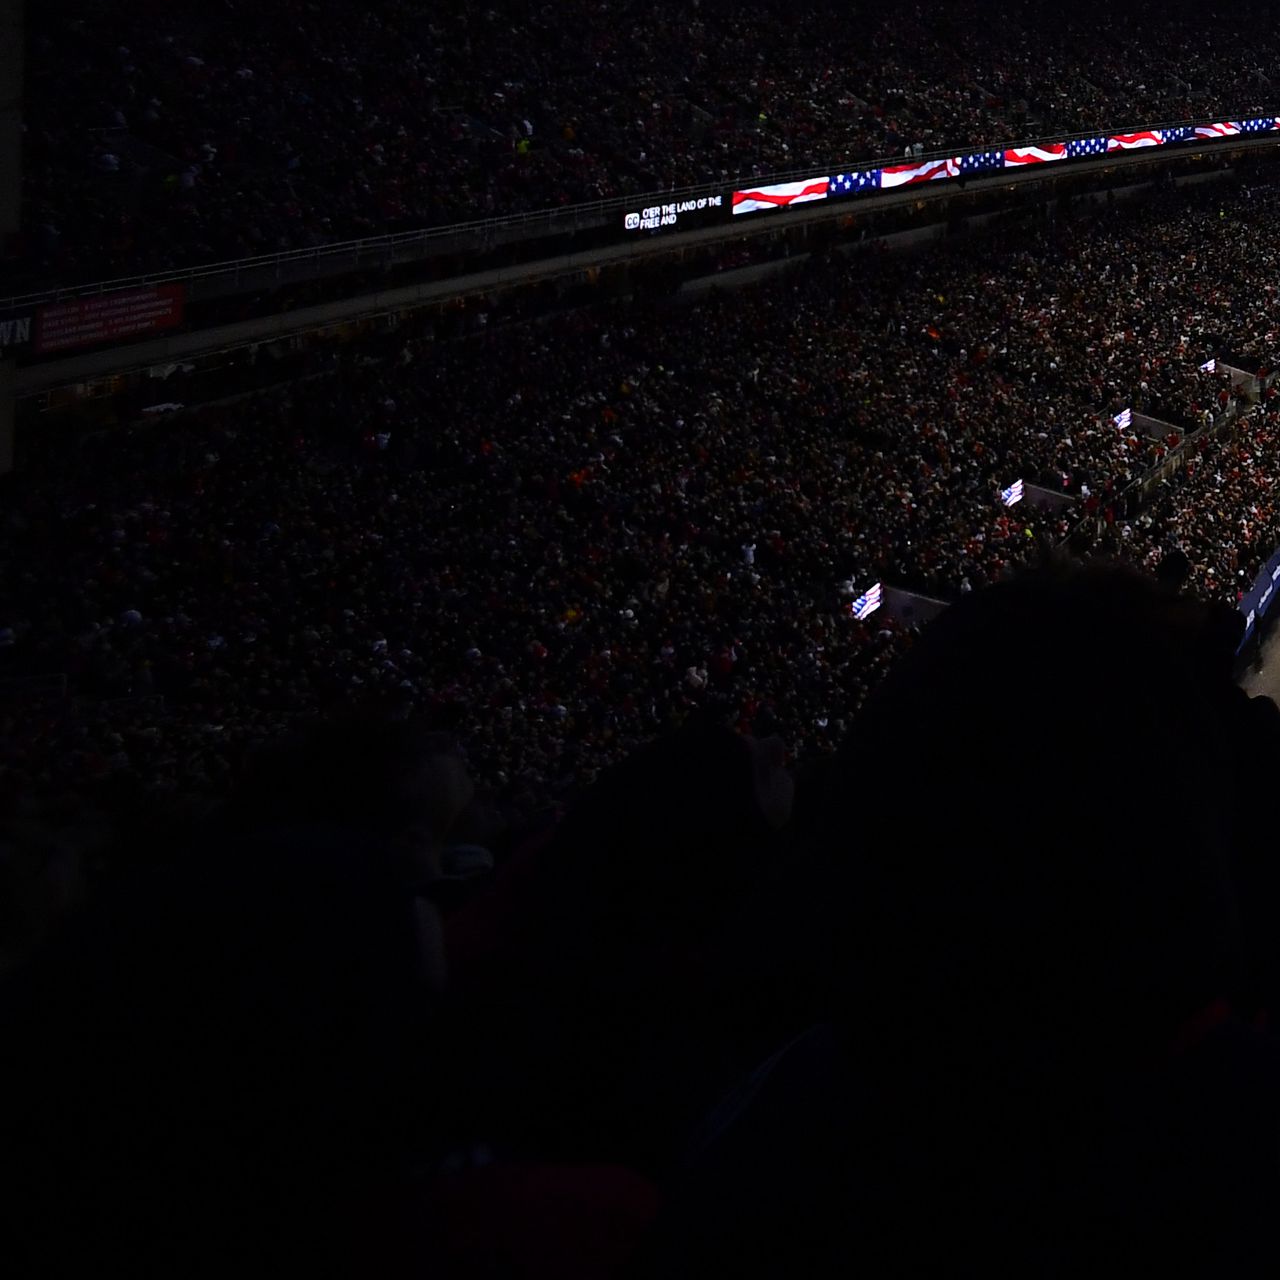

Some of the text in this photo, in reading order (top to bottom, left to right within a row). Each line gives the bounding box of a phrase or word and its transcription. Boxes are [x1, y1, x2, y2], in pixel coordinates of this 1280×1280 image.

[661, 203, 677, 216] THE
[677, 199, 697, 213] LAND
[697, 197, 708, 209] OF
[708, 195, 722, 207] THE
[640, 213, 677, 230] FREE AND
